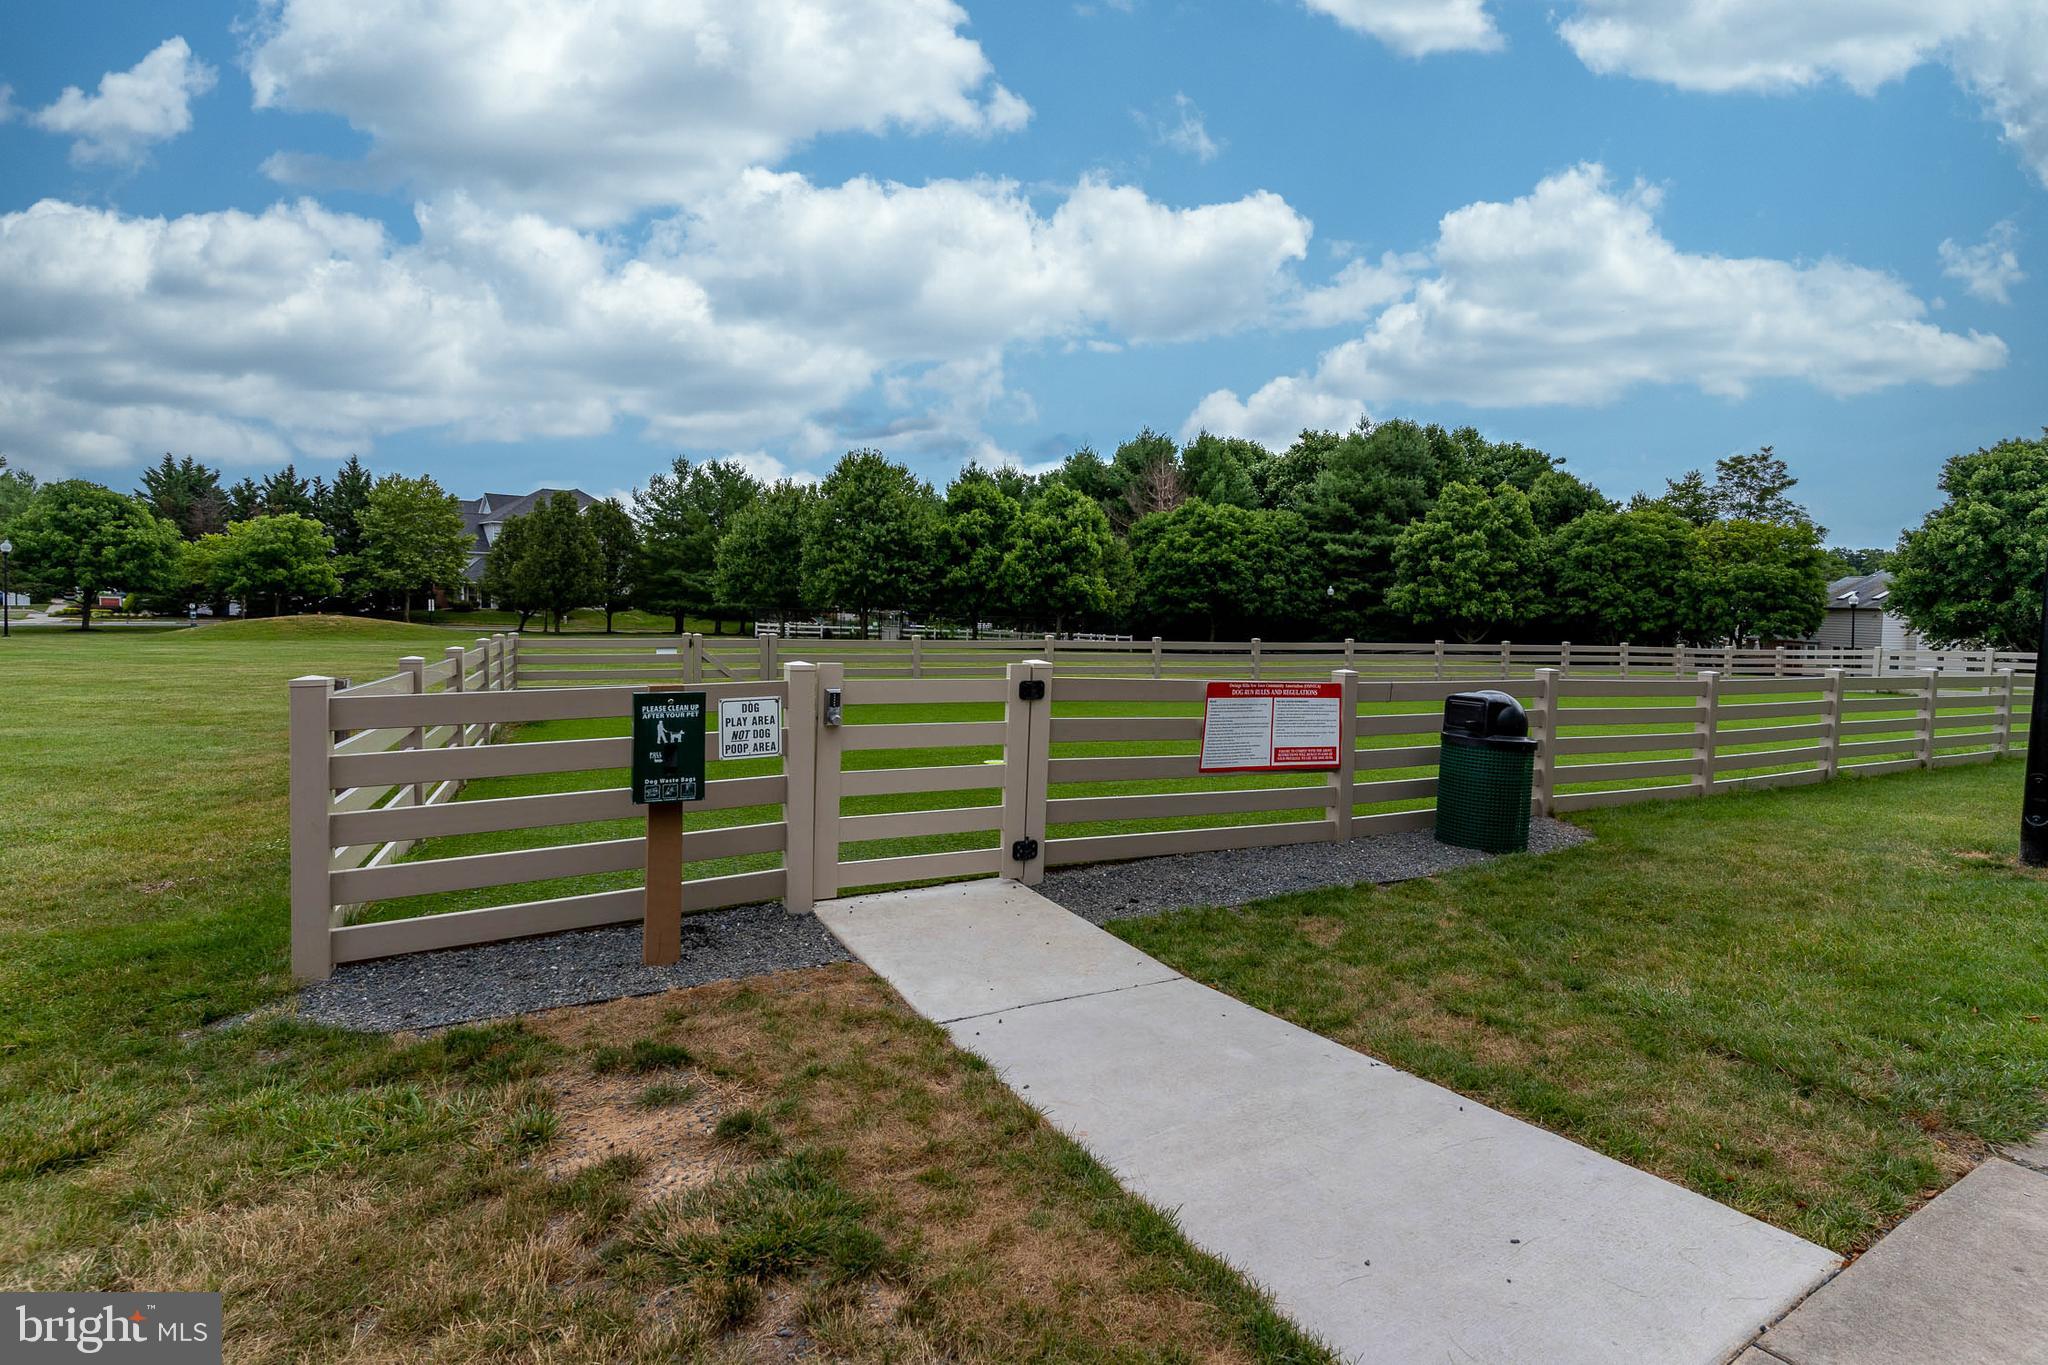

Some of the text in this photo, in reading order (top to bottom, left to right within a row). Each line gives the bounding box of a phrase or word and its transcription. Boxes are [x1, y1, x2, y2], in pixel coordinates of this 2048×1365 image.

[642, 705, 667, 714] PLEASE
[668, 704, 689, 712] CLEAN
[742, 703, 759, 713] DOG
[642, 710, 699, 720] AFTER YOUR PET
[725, 715, 776, 727] PLAY AREA
[731, 729, 771, 741] NOT DOG
[725, 742, 776, 754] POOP AREA
